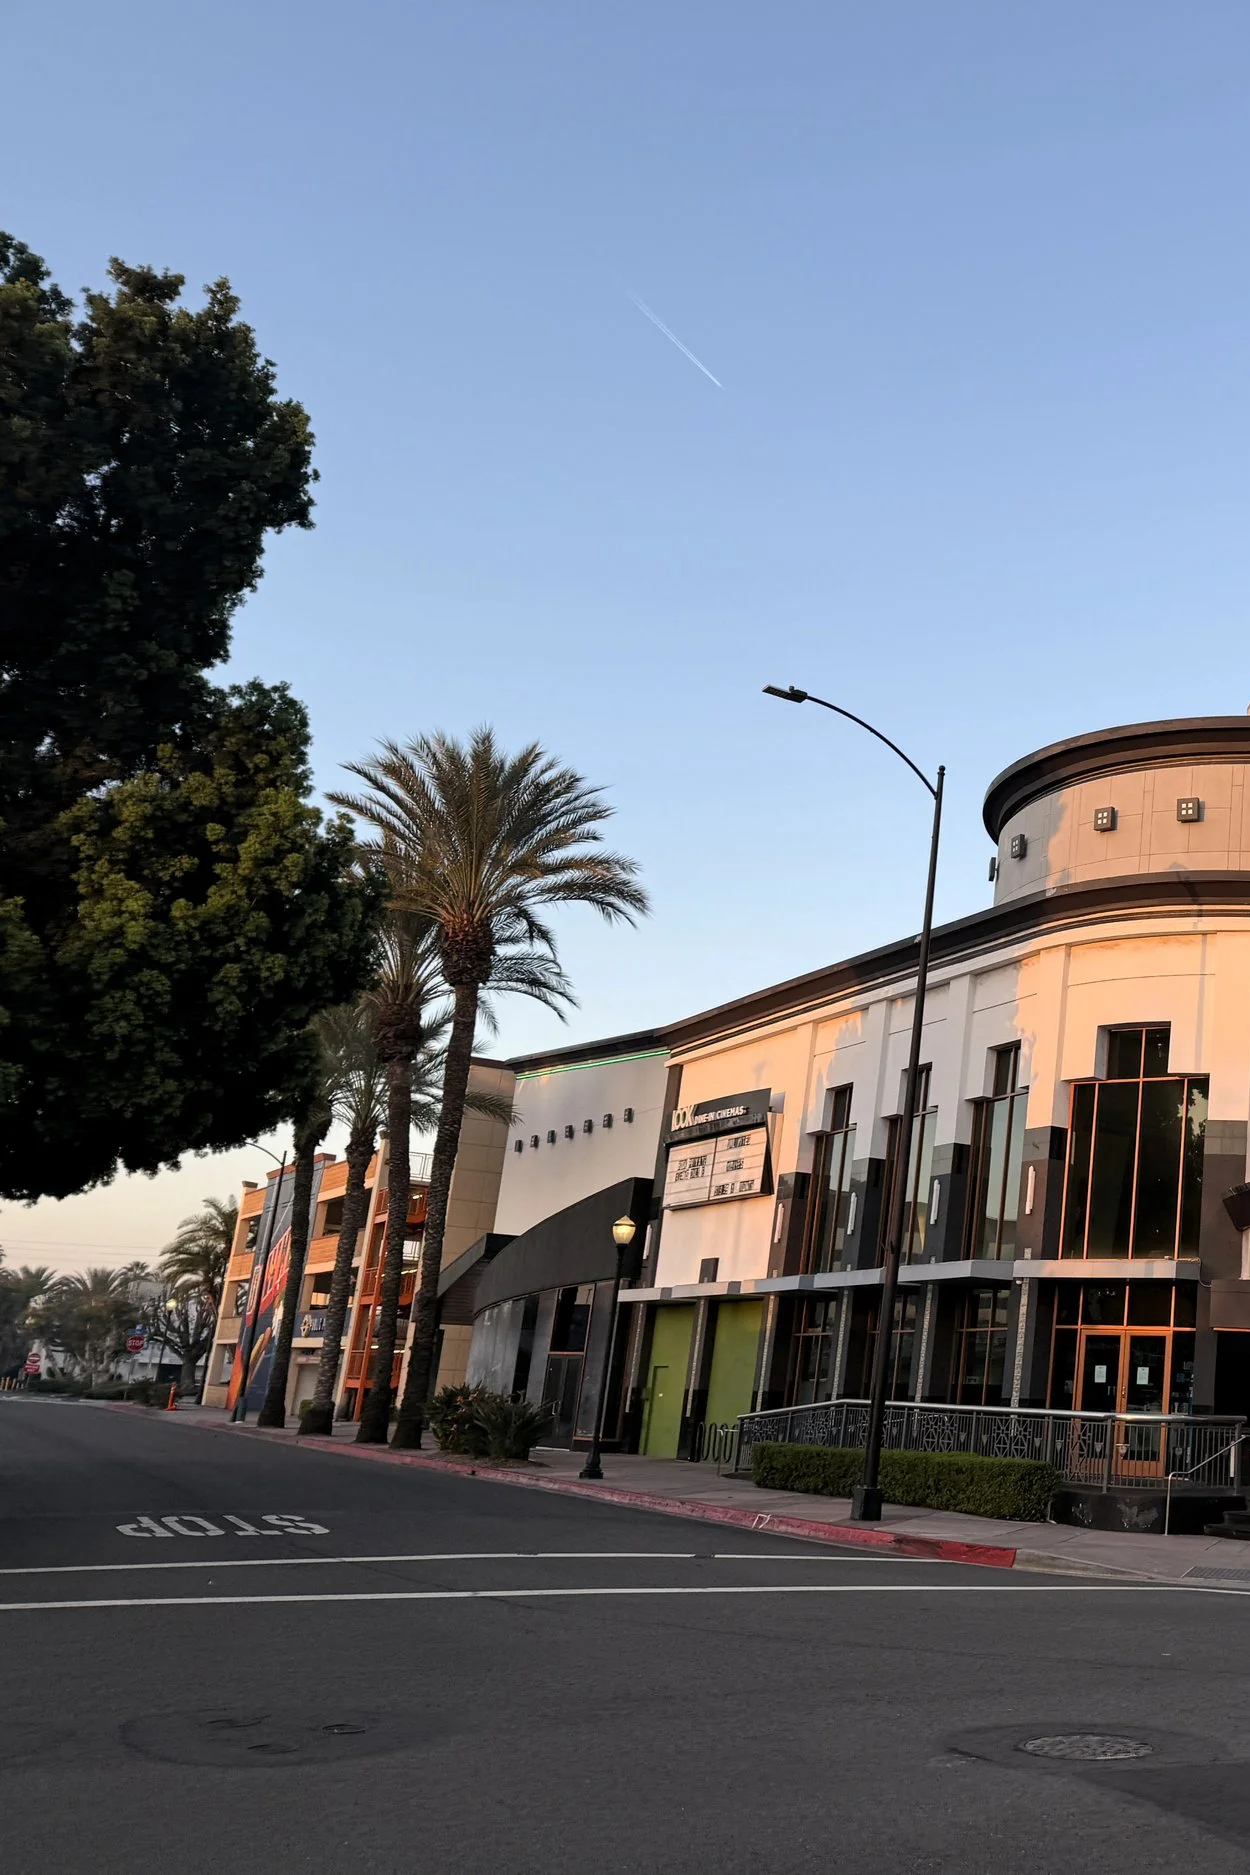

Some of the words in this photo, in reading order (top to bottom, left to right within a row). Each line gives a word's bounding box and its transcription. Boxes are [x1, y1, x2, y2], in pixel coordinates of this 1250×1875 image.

[671, 1105, 697, 1132] LOOK
[694, 1112, 715, 1125] DINE-IN
[716, 1105, 745, 1120] CINEMAS
[128, 1339, 145, 1347] STOP
[116, 1514, 330, 1537] STOP
